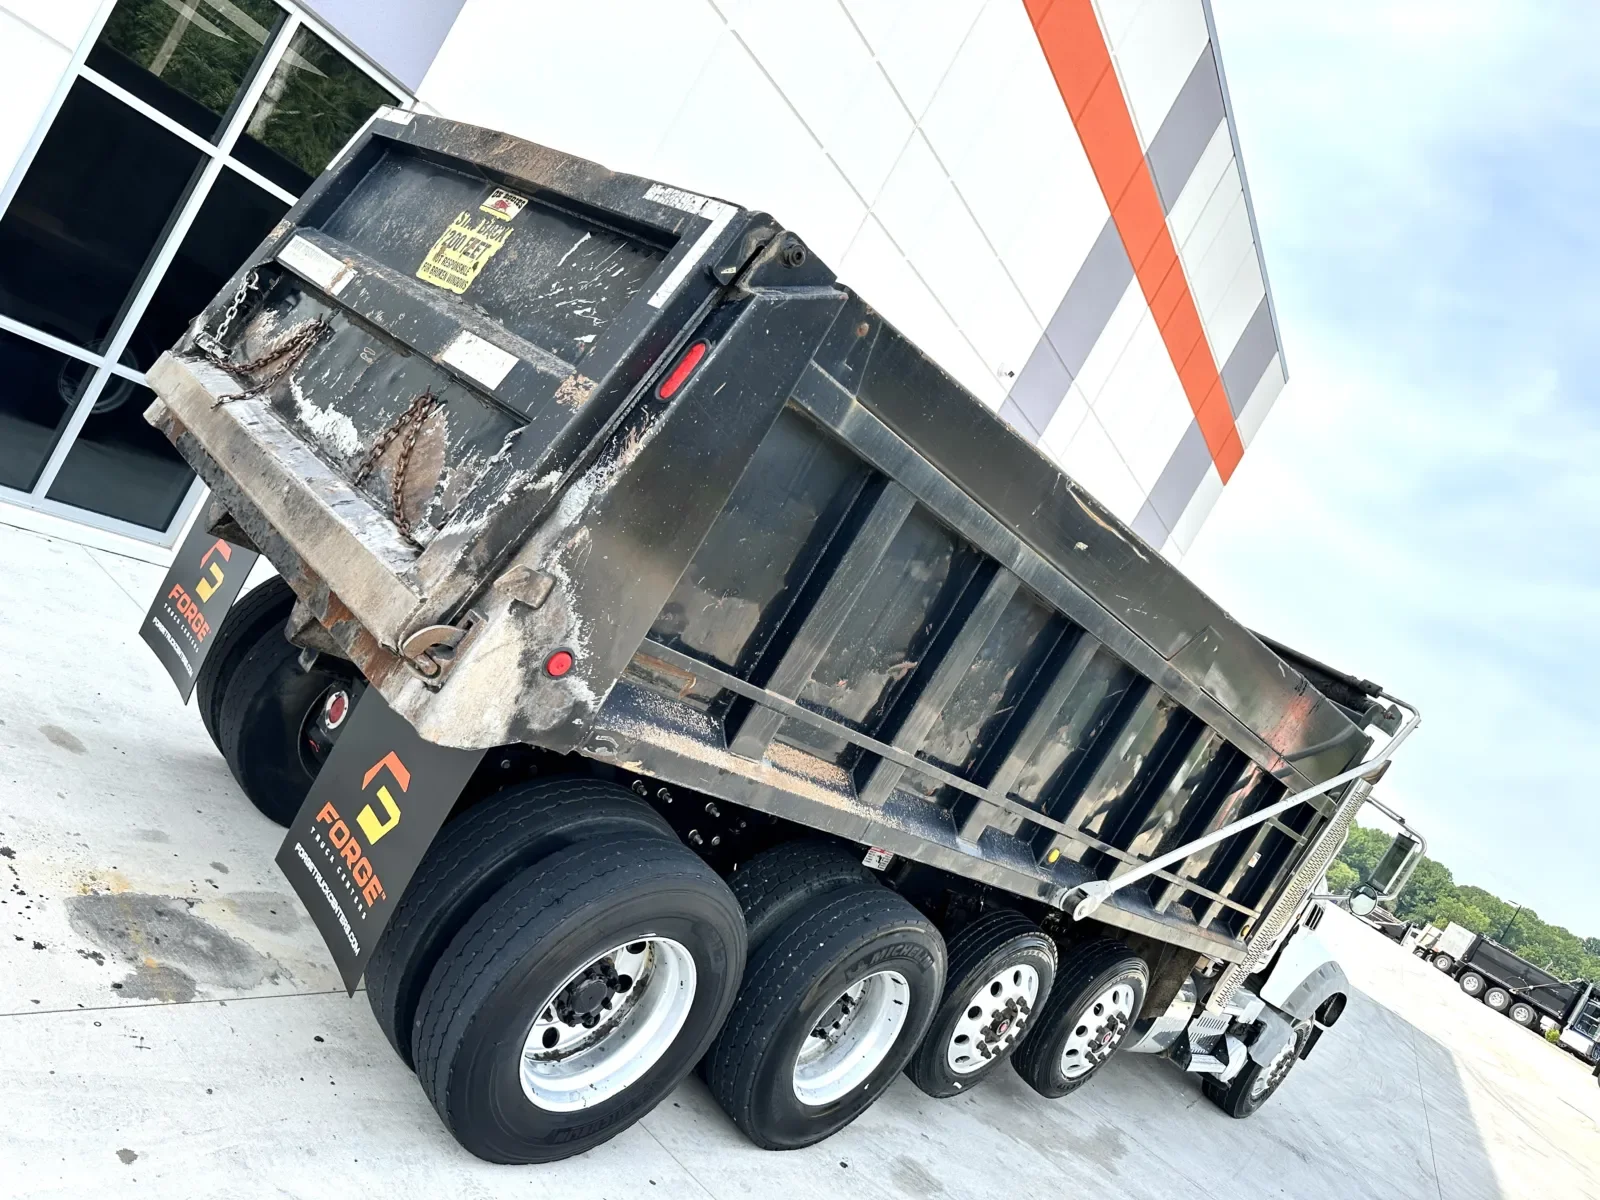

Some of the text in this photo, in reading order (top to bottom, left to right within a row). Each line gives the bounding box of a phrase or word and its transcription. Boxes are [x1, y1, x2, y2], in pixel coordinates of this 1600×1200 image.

[442, 230, 492, 260] 200 FEET
[455, 210, 512, 243] ST BACK
[421, 262, 431, 273] FOR
[429, 264, 447, 281] BROKEN
[168, 583, 211, 643] FORGE
[310, 826, 366, 920] TRUCK CENTERS
[315, 801, 384, 908] FORGE
[294, 842, 361, 957] FORGETRUCKCENTERS.COM
